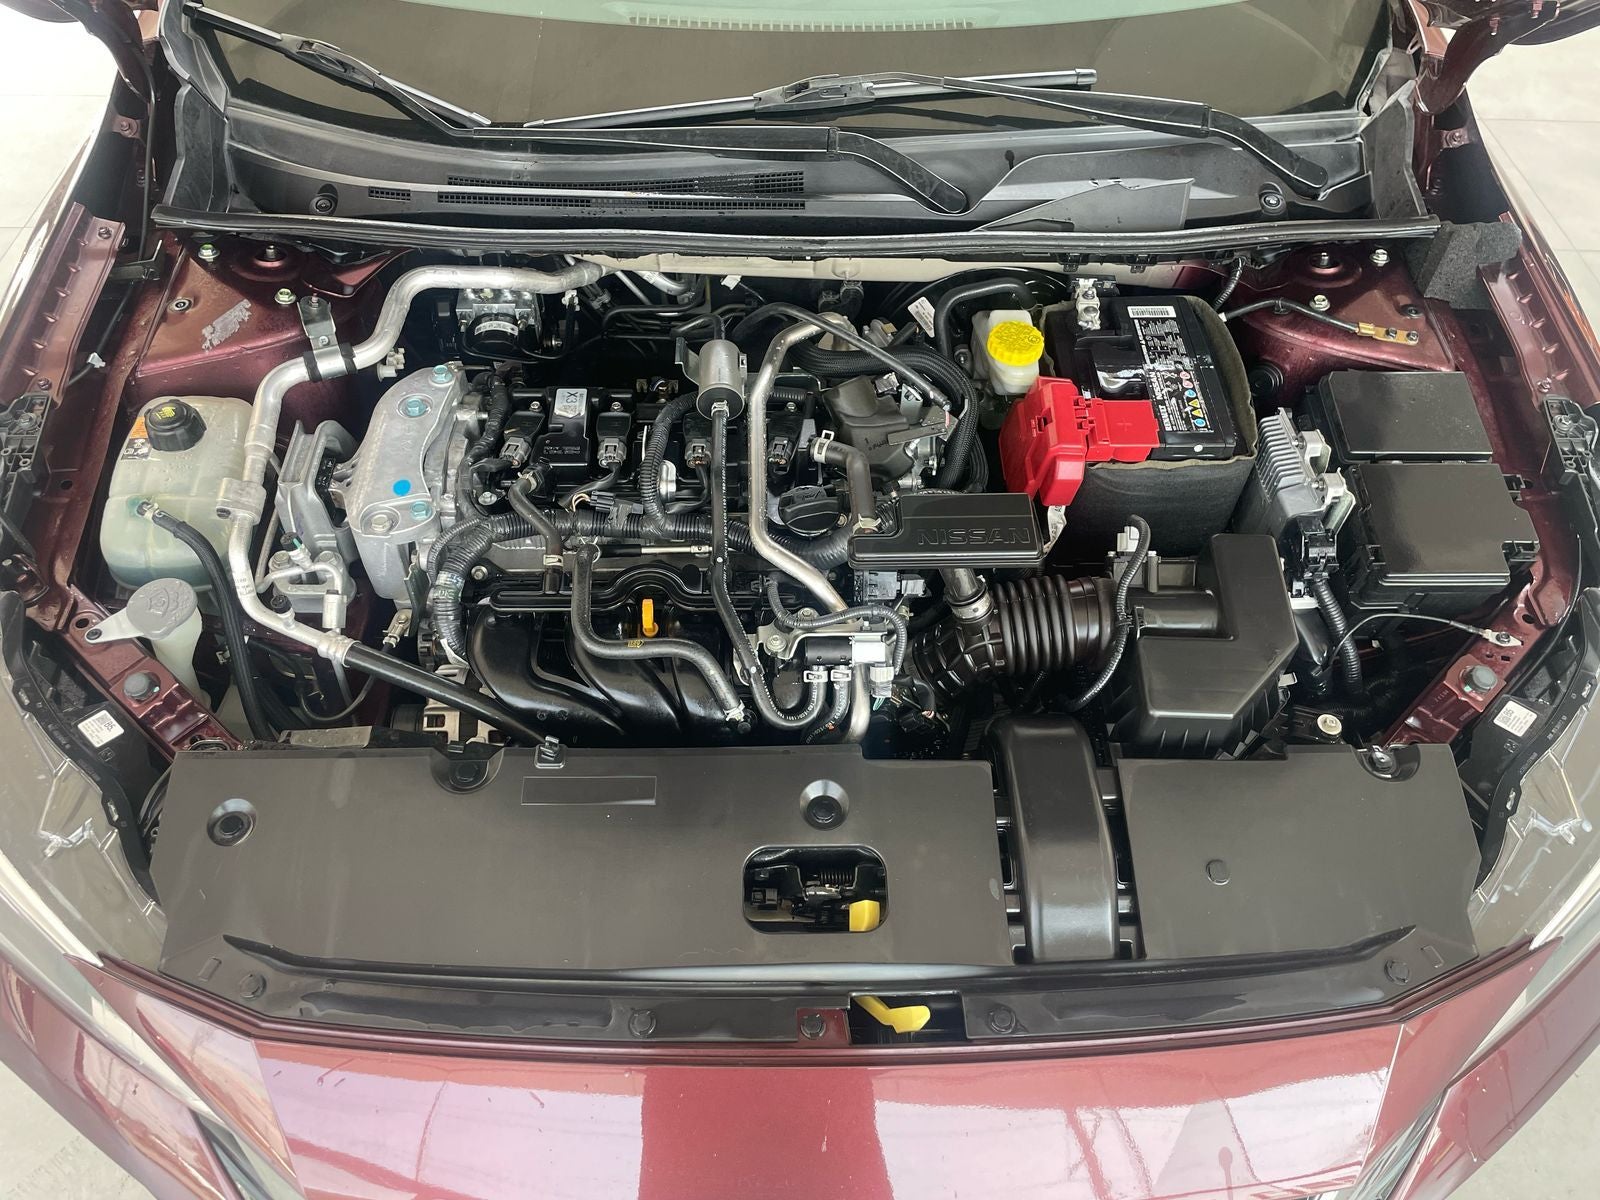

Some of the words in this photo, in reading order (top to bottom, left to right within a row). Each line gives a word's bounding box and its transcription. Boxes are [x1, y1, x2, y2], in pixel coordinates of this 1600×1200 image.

[1148, 371, 1163, 400] NISSAN
[566, 392, 578, 403] X3
[917, 527, 1031, 545] NISSAN
